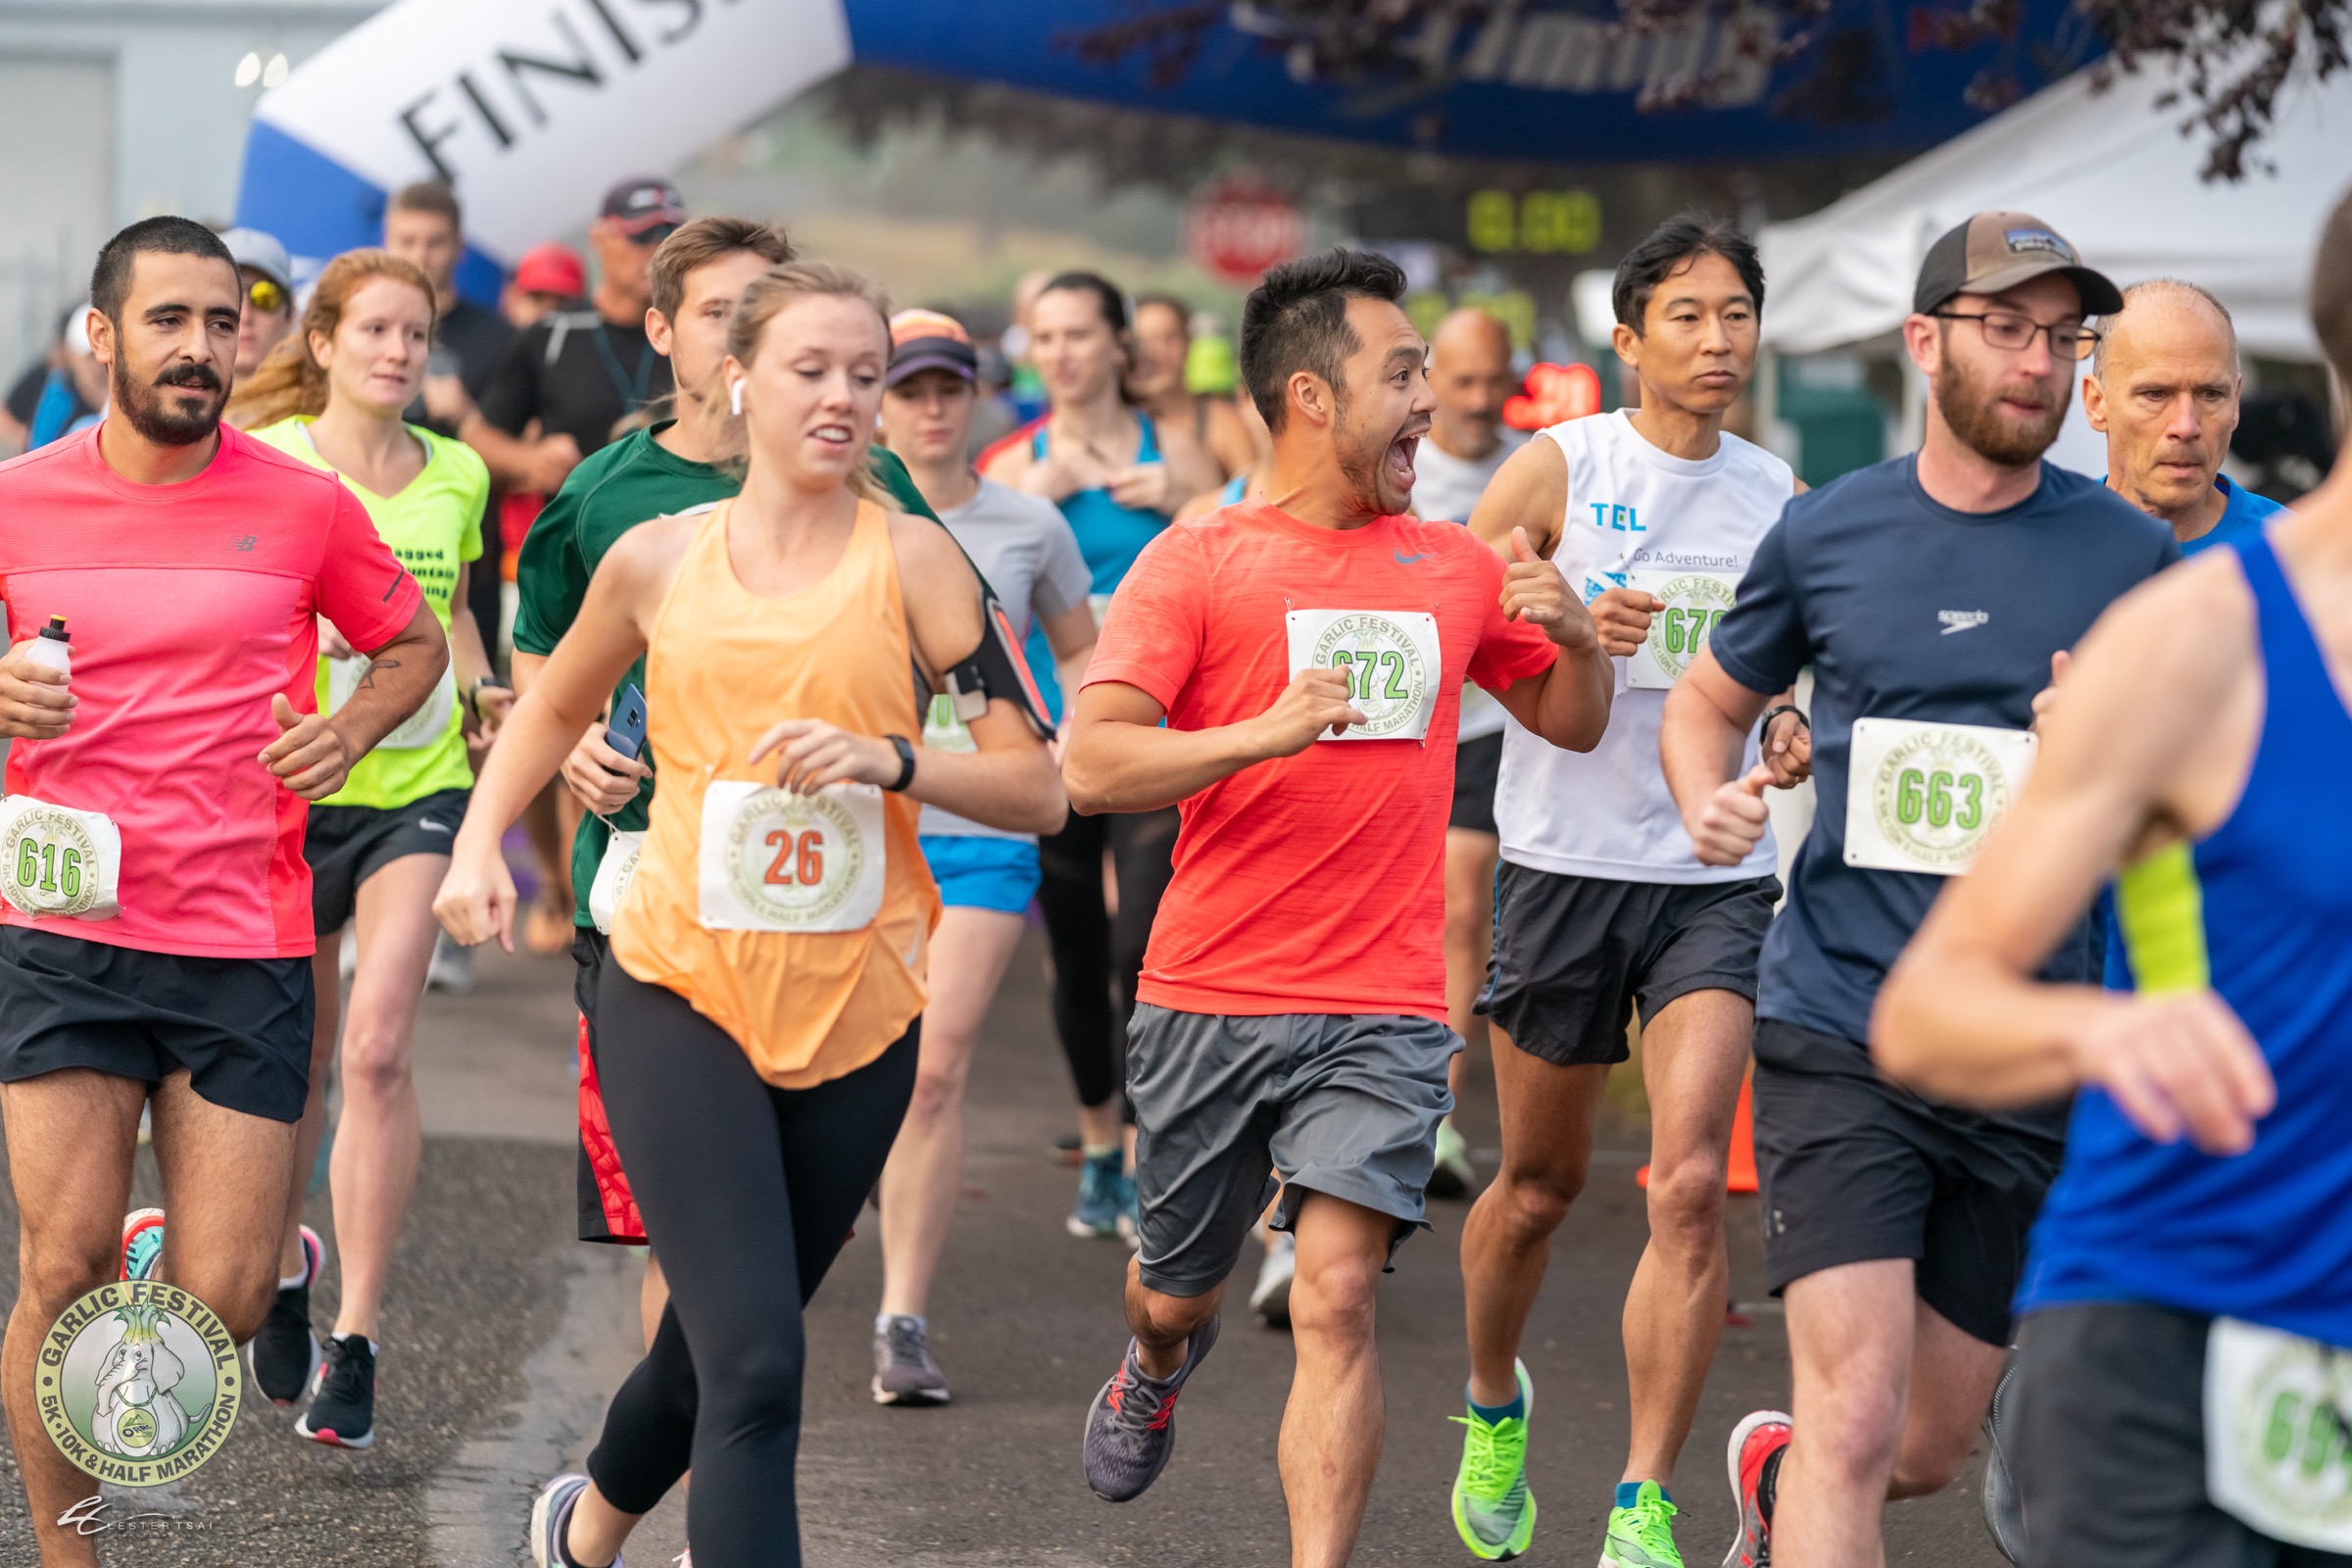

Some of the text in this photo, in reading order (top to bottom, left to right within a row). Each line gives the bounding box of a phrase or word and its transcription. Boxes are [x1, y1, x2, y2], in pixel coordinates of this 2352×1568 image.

[397, 0, 730, 187] FINIS
[1590, 503, 1646, 531] TEL
[1634, 547, 1739, 567] Go Adventure!
[1693, 577, 1739, 609] FESTIV
[1315, 616, 1419, 666] GARLIC FESTIVAL
[1333, 650, 1408, 700] 672
[1383, 681, 1422, 730] MARATHON
[1897, 767, 1983, 829] 663
[5, 809, 95, 868] GARLIC FESTIVAL
[763, 829, 823, 887] 26
[17, 837, 81, 898] 616
